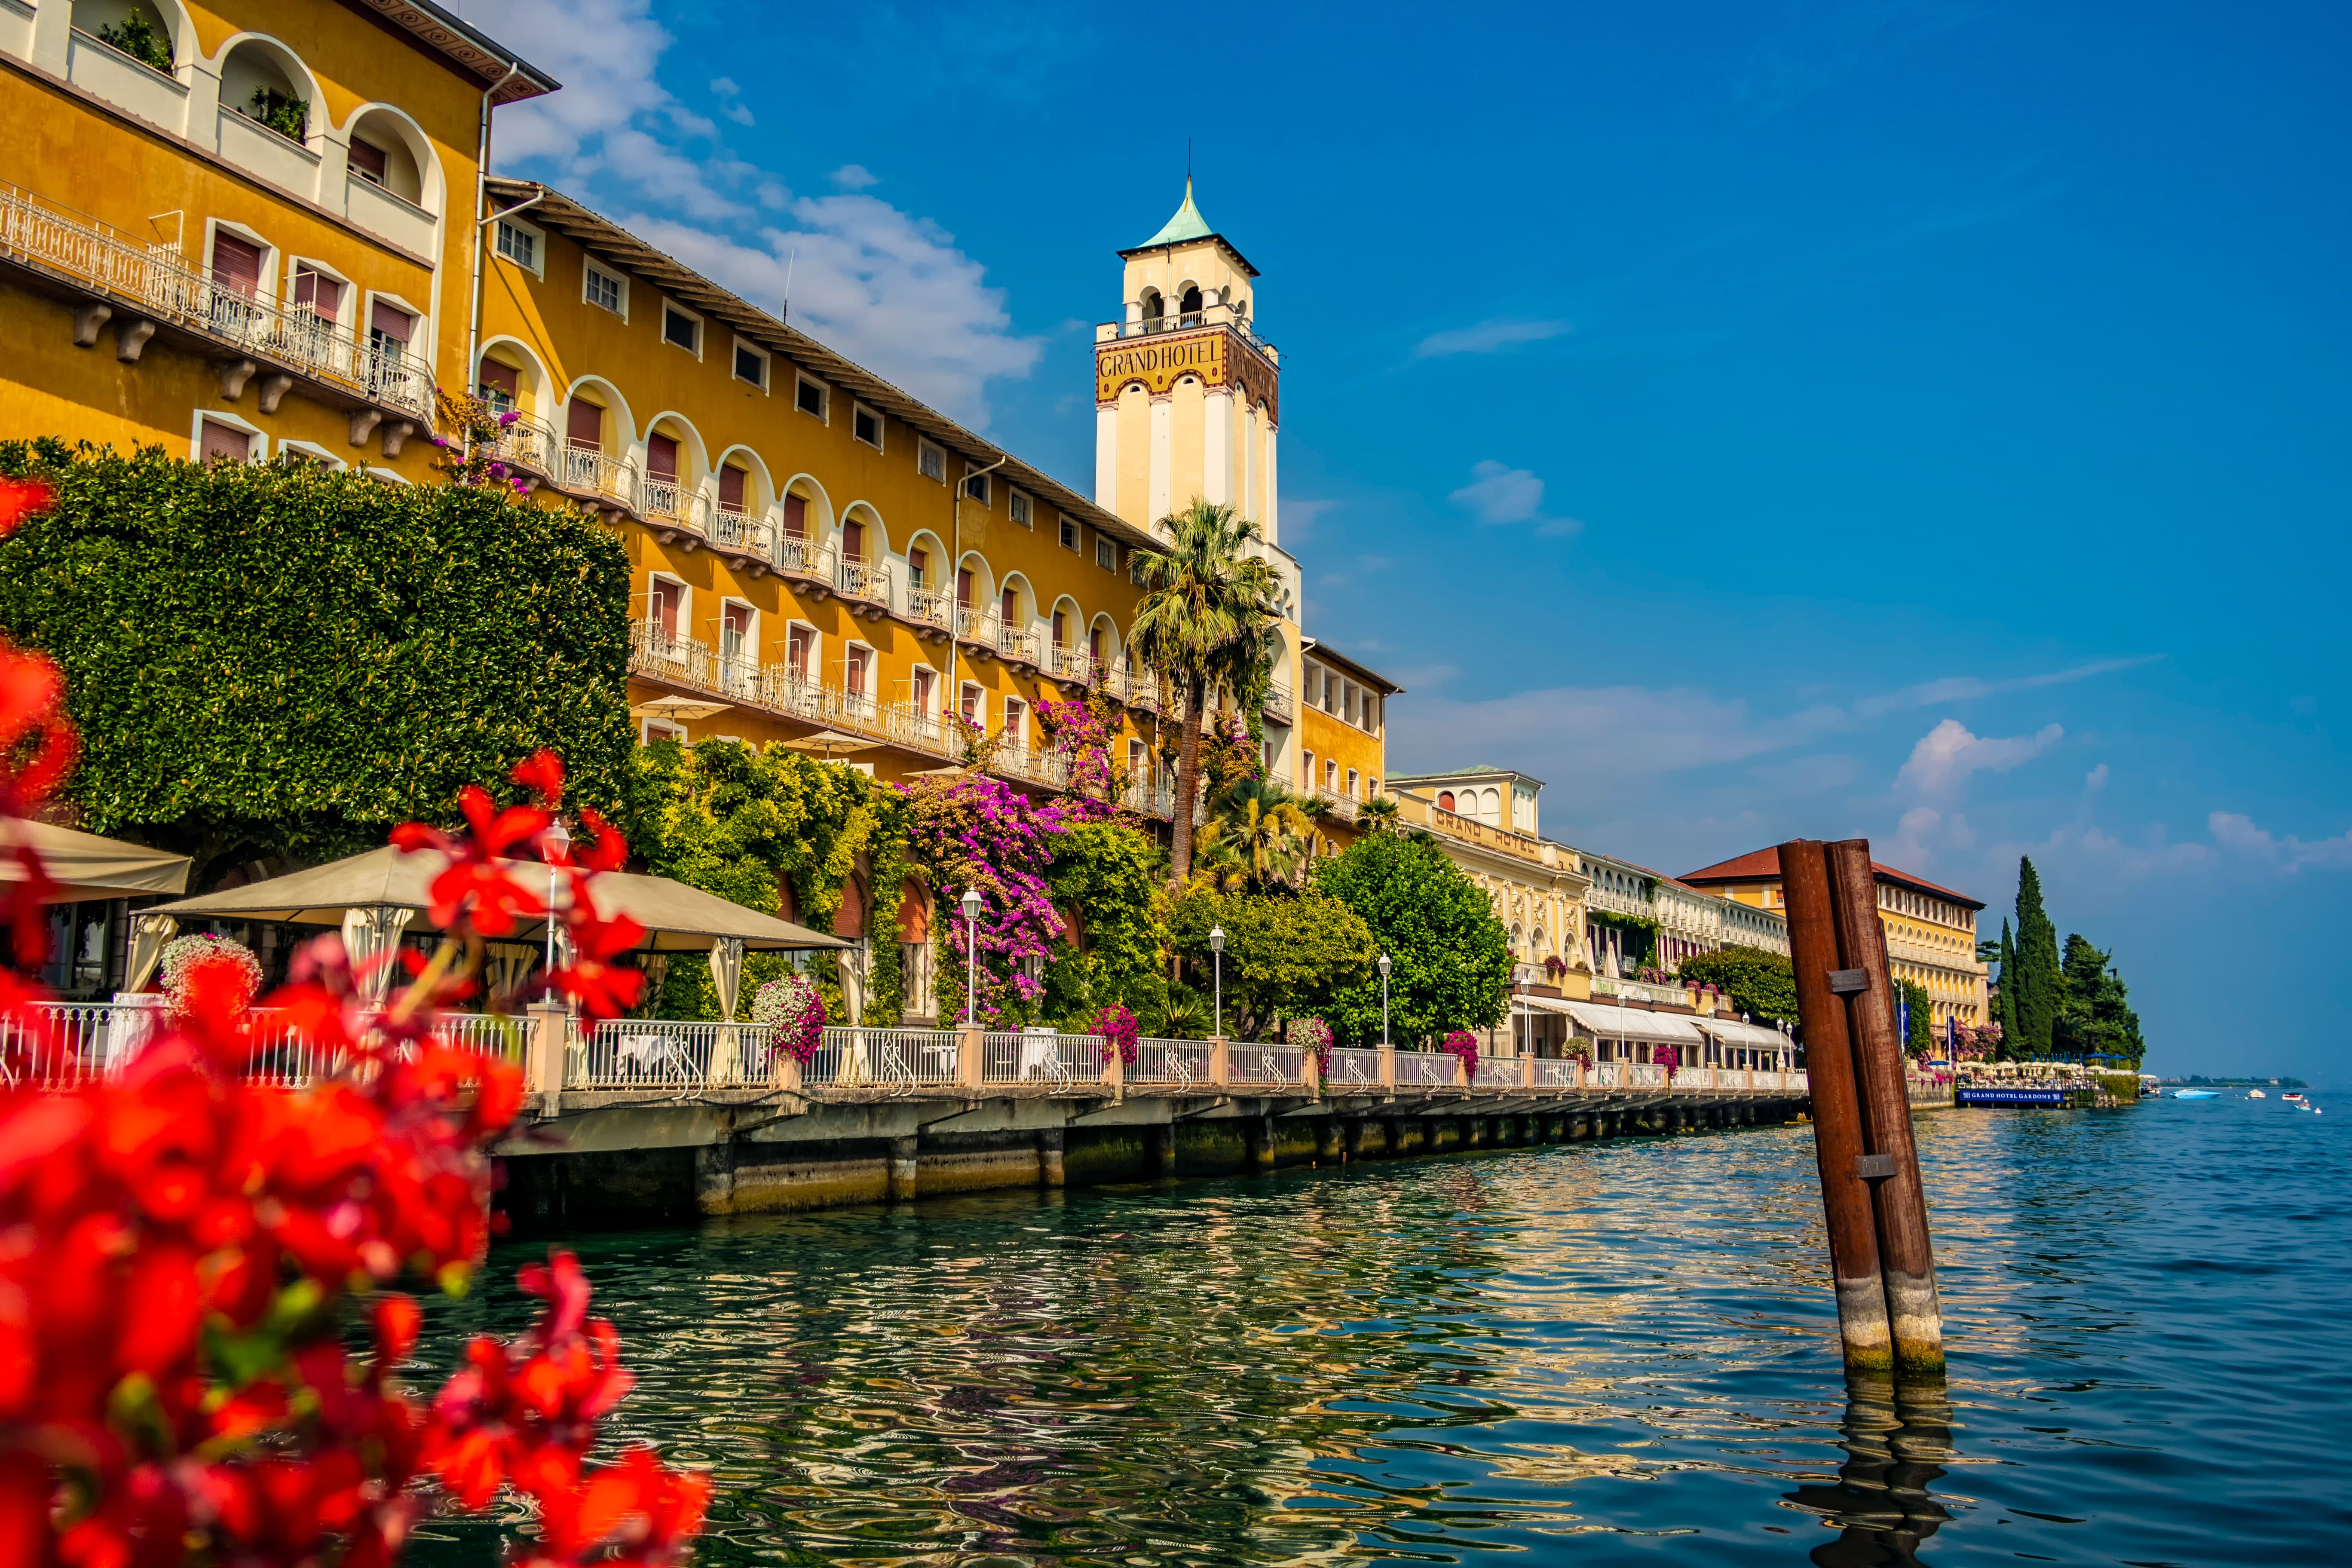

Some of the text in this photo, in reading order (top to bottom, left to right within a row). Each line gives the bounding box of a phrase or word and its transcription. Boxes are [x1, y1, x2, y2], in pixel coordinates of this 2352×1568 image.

[1100, 340, 1222, 377] GRAND HOTEL
[1436, 810, 1534, 854] GRAND HOTEL
